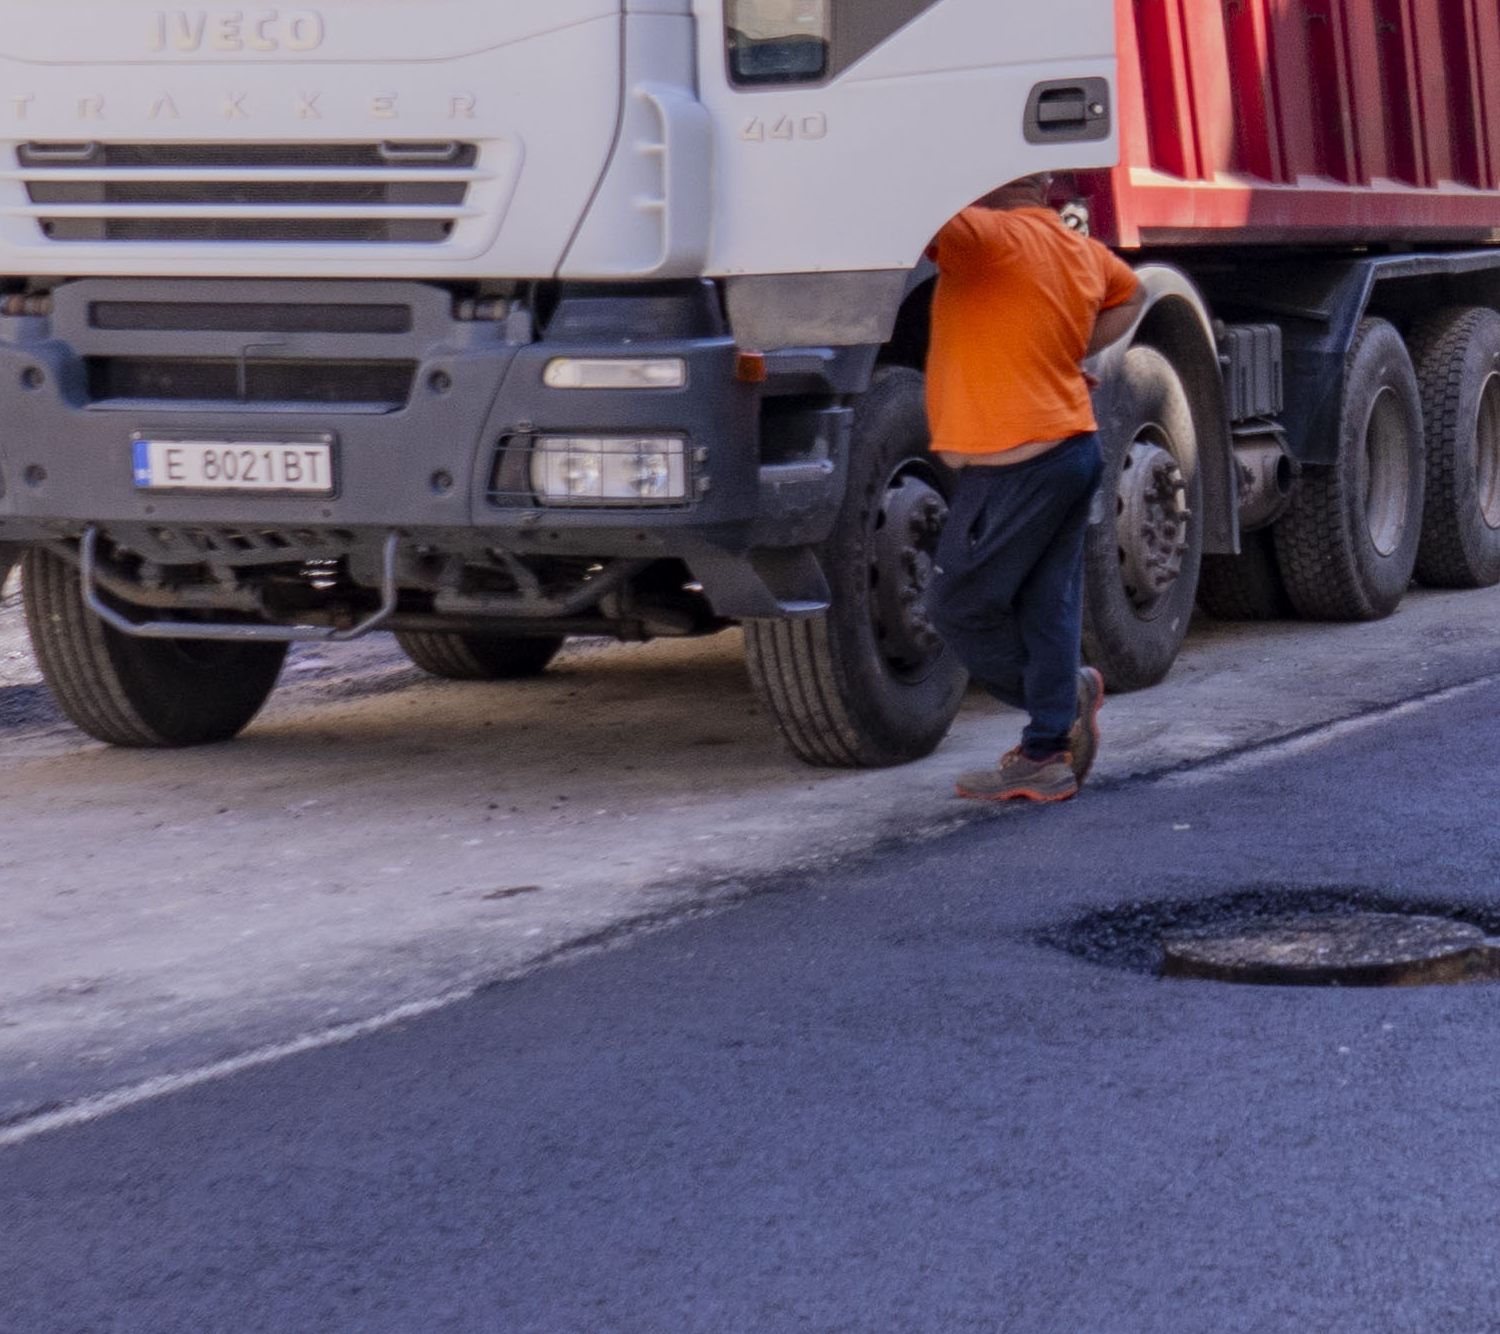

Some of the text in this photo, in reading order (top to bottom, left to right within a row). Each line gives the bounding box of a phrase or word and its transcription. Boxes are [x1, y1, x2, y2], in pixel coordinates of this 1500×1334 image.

[147, 9, 326, 53] IVECO
[12, 90, 477, 120] TRAKKER
[740, 114, 828, 142] 440
[166, 449, 187, 480] E
